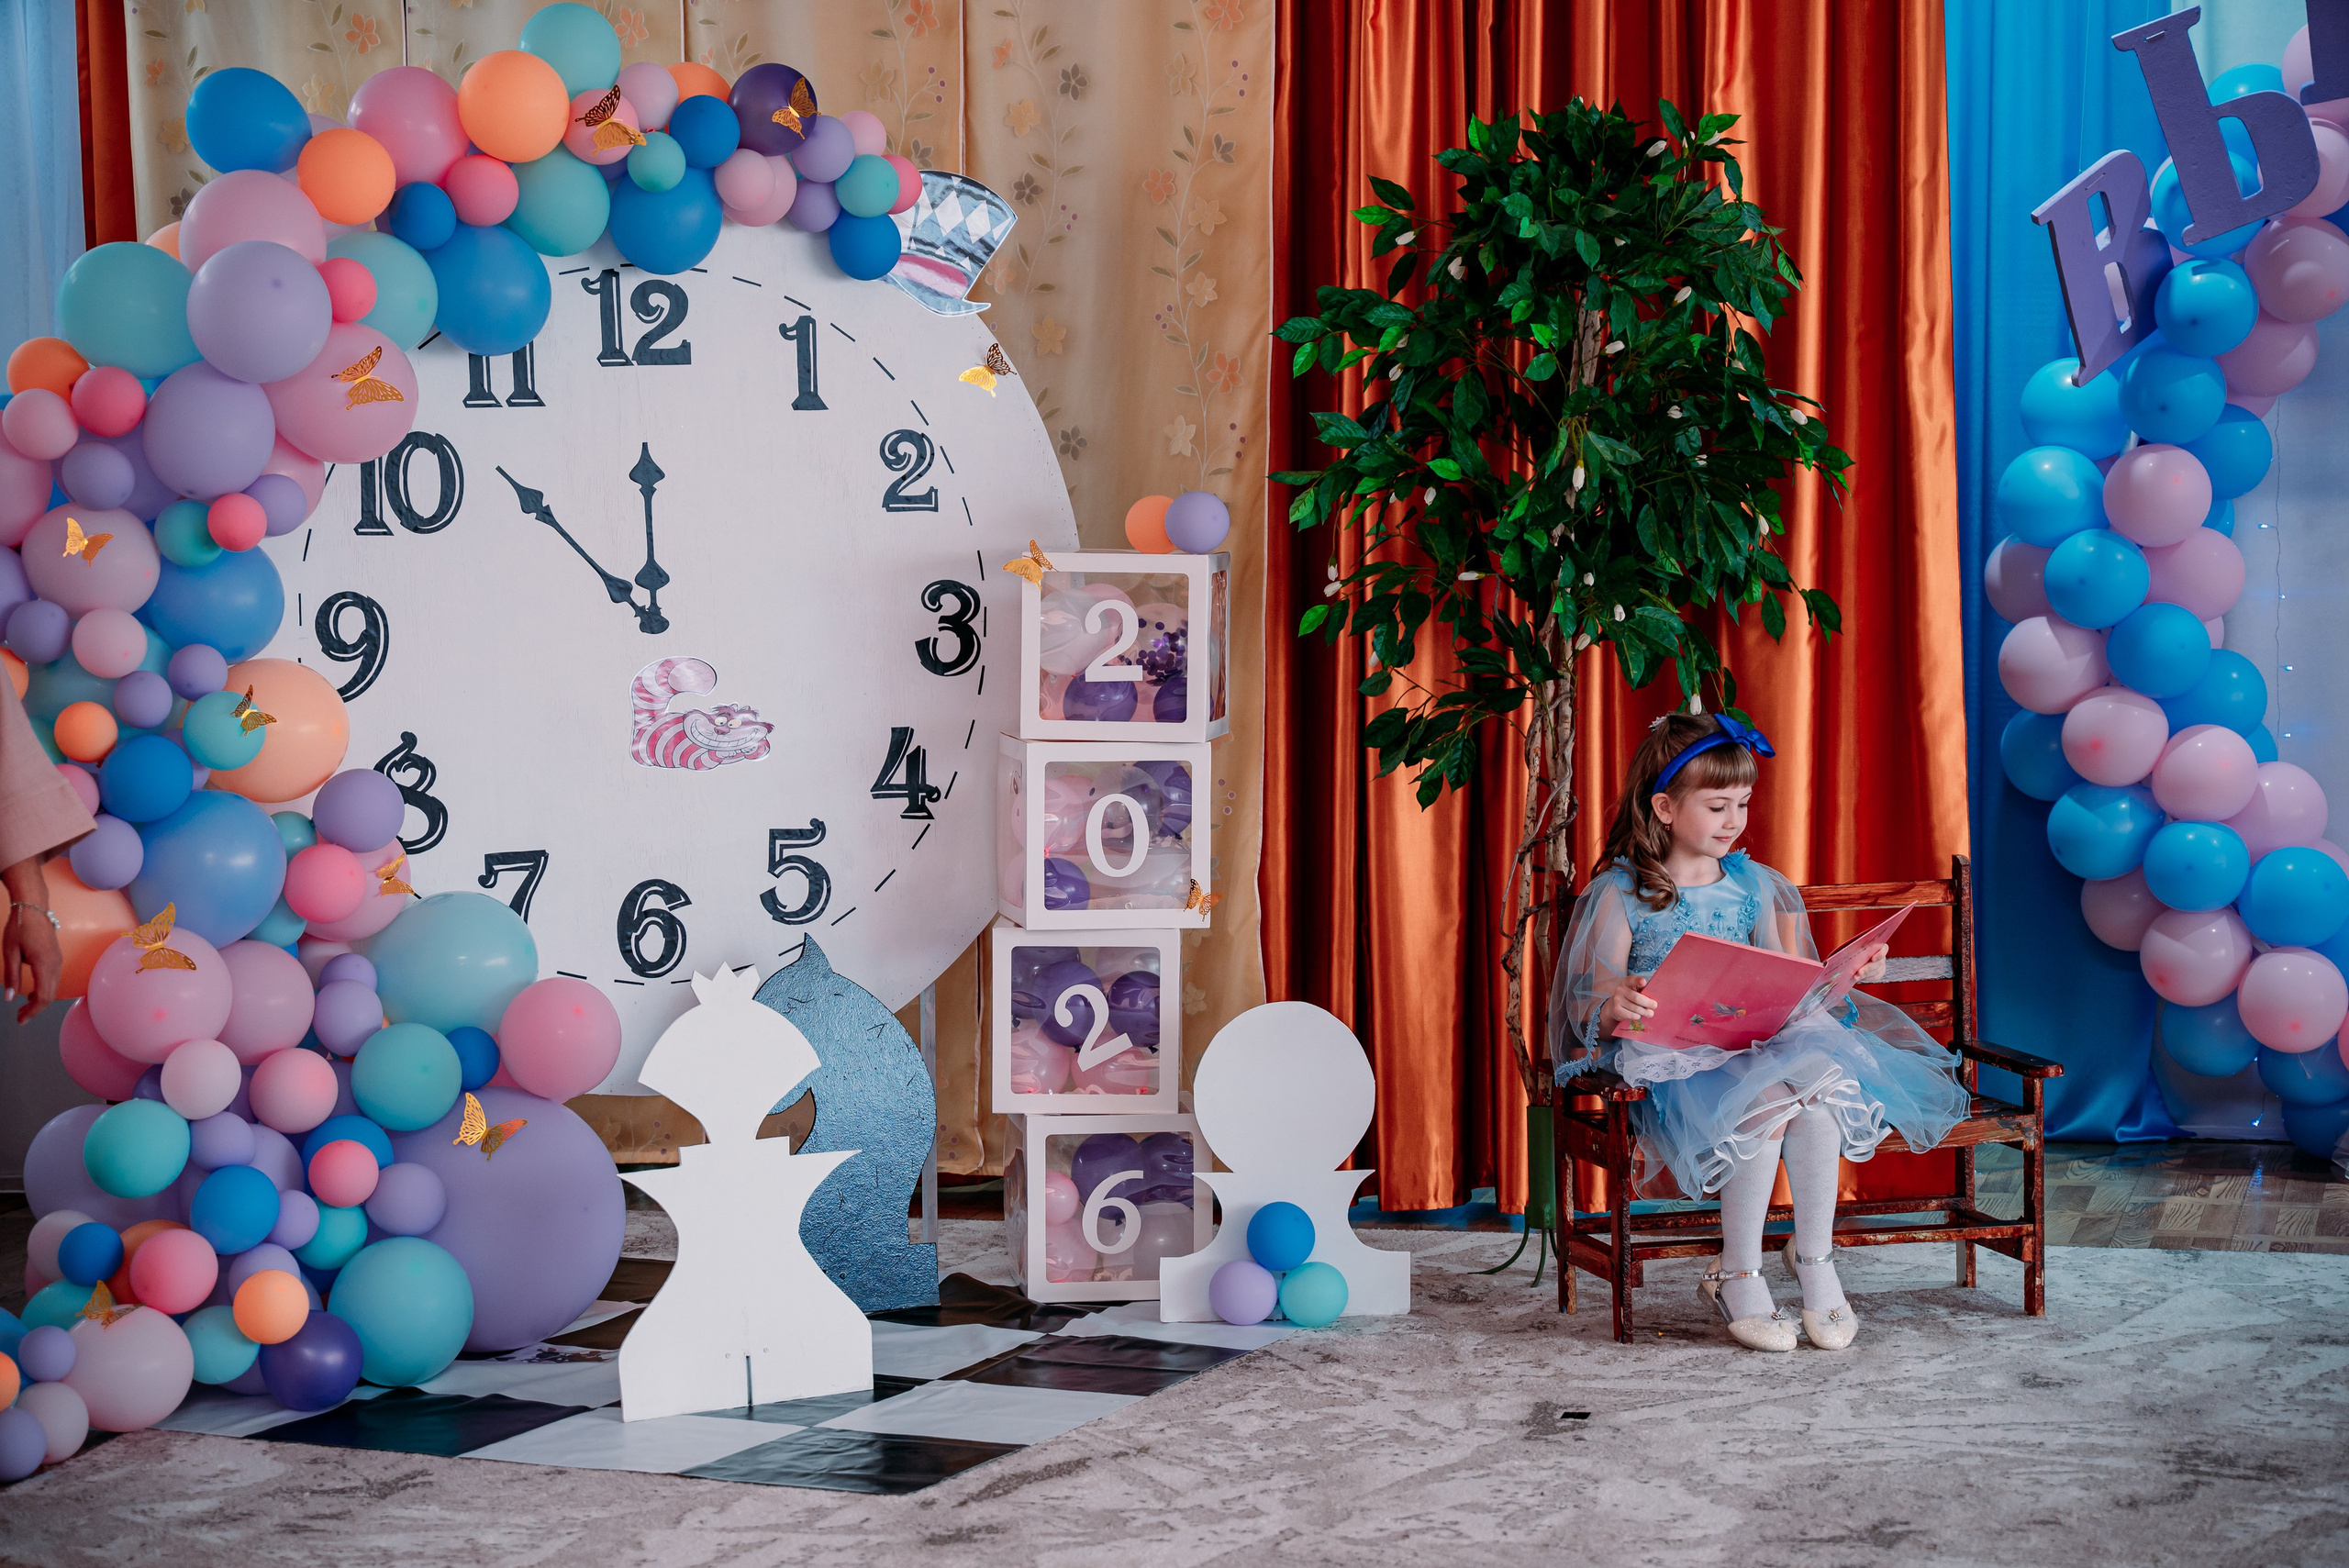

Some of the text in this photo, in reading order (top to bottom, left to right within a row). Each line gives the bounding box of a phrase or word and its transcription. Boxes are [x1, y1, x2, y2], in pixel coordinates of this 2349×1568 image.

[581, 269, 691, 366] 12
[778, 316, 829, 410] 1
[353, 431, 463, 536] 10
[879, 429, 939, 512] 2
[315, 591, 389, 703] 9
[915, 579, 981, 676] 3
[373, 731, 449, 855] 8
[870, 727, 941, 820] 4
[478, 850, 549, 924] 7
[760, 817, 831, 925] 5
[618, 879, 692, 978] 6
